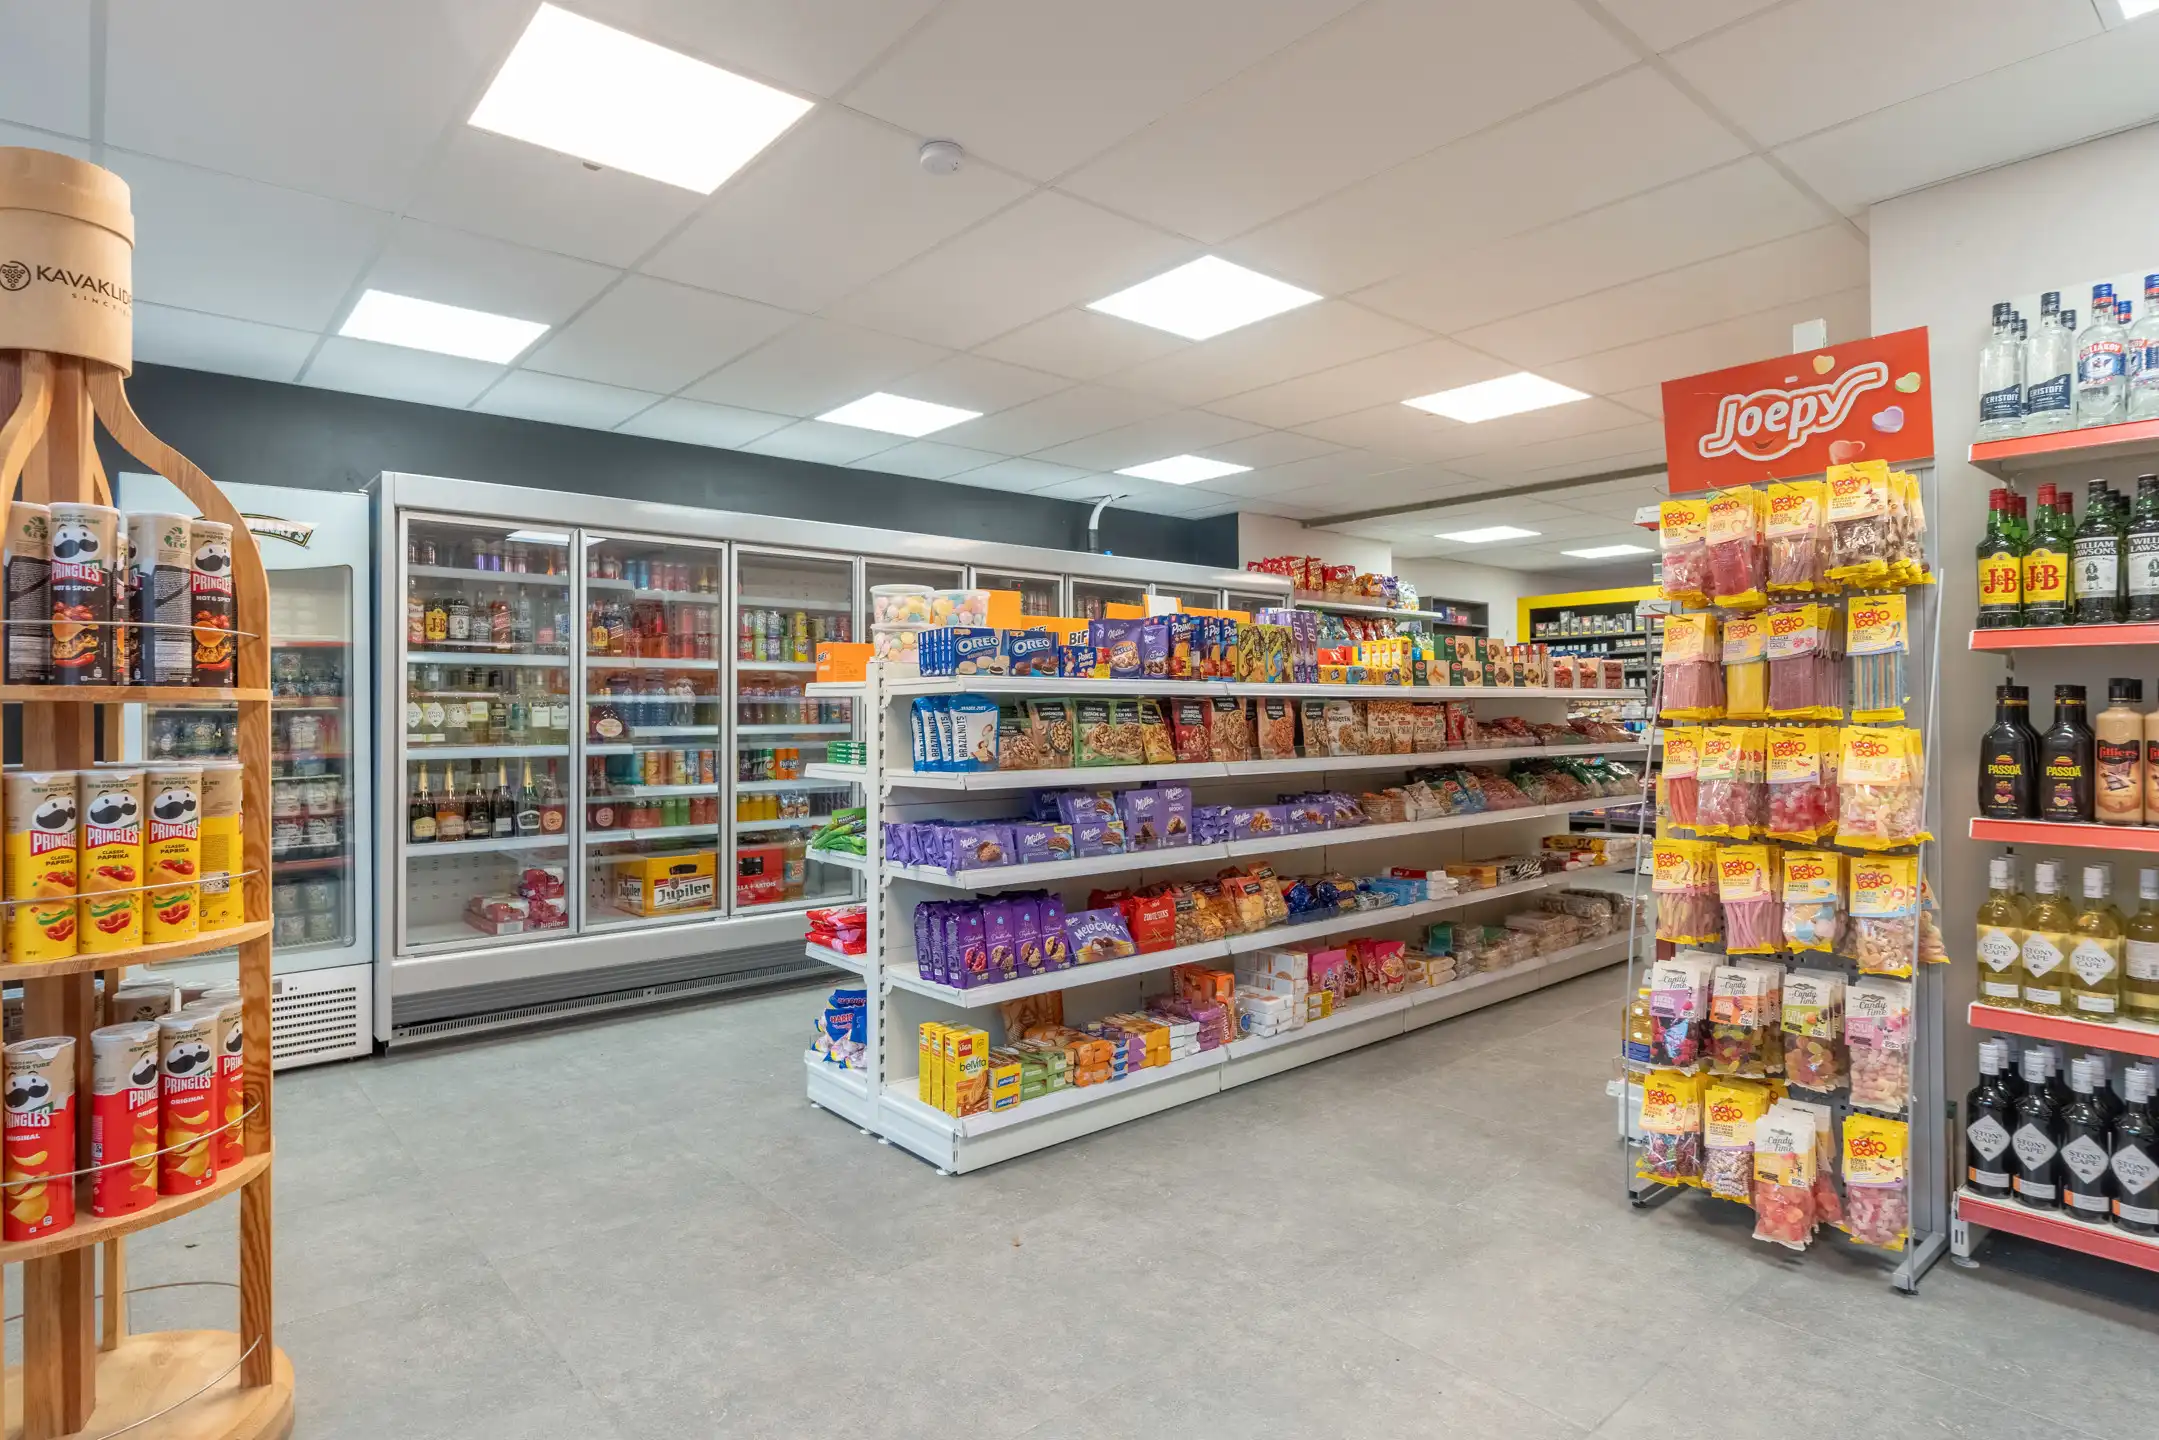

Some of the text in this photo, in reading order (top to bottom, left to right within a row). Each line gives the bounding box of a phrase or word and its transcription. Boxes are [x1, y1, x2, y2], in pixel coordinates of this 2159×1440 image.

[2030, 385, 2064, 398] ERISTOFF
[1985, 393, 2019, 404] ERISTOFF
[1704, 367, 1882, 453] Joepy
[2075, 541, 2114, 550] WILLIAM
[52, 562, 102, 583] PRINGLES
[2026, 564, 2060, 592] J&B
[1984, 568, 2017, 594] J&B
[1107, 628, 1125, 640] Milka
[1293, 621, 1304, 641] LEO
[1306, 620, 1316, 641] LEO
[1069, 629, 1088, 646] BiF
[957, 636, 1000, 654] OREO
[1013, 638, 1051, 655] OREO
[927, 716, 939, 758] BRAZILNUTS
[956, 715, 967, 758] BRAZILNUTS
[1073, 796, 1093, 808] Milka
[1134, 796, 1154, 811] Milka
[1233, 813, 1251, 827] Milka
[1291, 808, 1304, 820] Milka
[87, 826, 139, 848] PRINGLES
[150, 821, 198, 841] PRINGLES
[1081, 827, 1101, 841] Milka
[960, 836, 978, 848] Milka
[1024, 832, 1046, 846] Milka
[619, 883, 641, 897] Jupiler
[658, 883, 711, 903] Jupiler
[1983, 943, 2013, 951] STONY
[1984, 949, 2009, 957] CAPE
[2024, 947, 2053, 957] STONY
[2025, 953, 2050, 962] CAPE
[2075, 954, 2107, 963] STONY
[1663, 975, 1687, 985] Candy
[1724, 982, 1747, 992] Candy
[1793, 991, 1817, 1001] Candy
[1858, 1001, 1887, 1012] Candy
[1867, 1008, 1887, 1016] Time
[960, 1056, 987, 1072] belvita
[164, 1069, 211, 1095] PRINGLES
[171, 1095, 204, 1105] ORIGINAL
[6, 1106, 51, 1129] RINGLES
[1972, 1129, 2003, 1140] STONY
[1975, 1135, 2000, 1145] CAPE
[1767, 1136, 1793, 1147] Candy
[2016, 1137, 2047, 1150] STONY
[2017, 1144, 2043, 1155] CAPE
[2068, 1149, 2102, 1161] STONY
[2070, 1157, 2099, 1167] CAPE
[2116, 1159, 2150, 1172] STONY
[2118, 1166, 2145, 1178] CAPE
